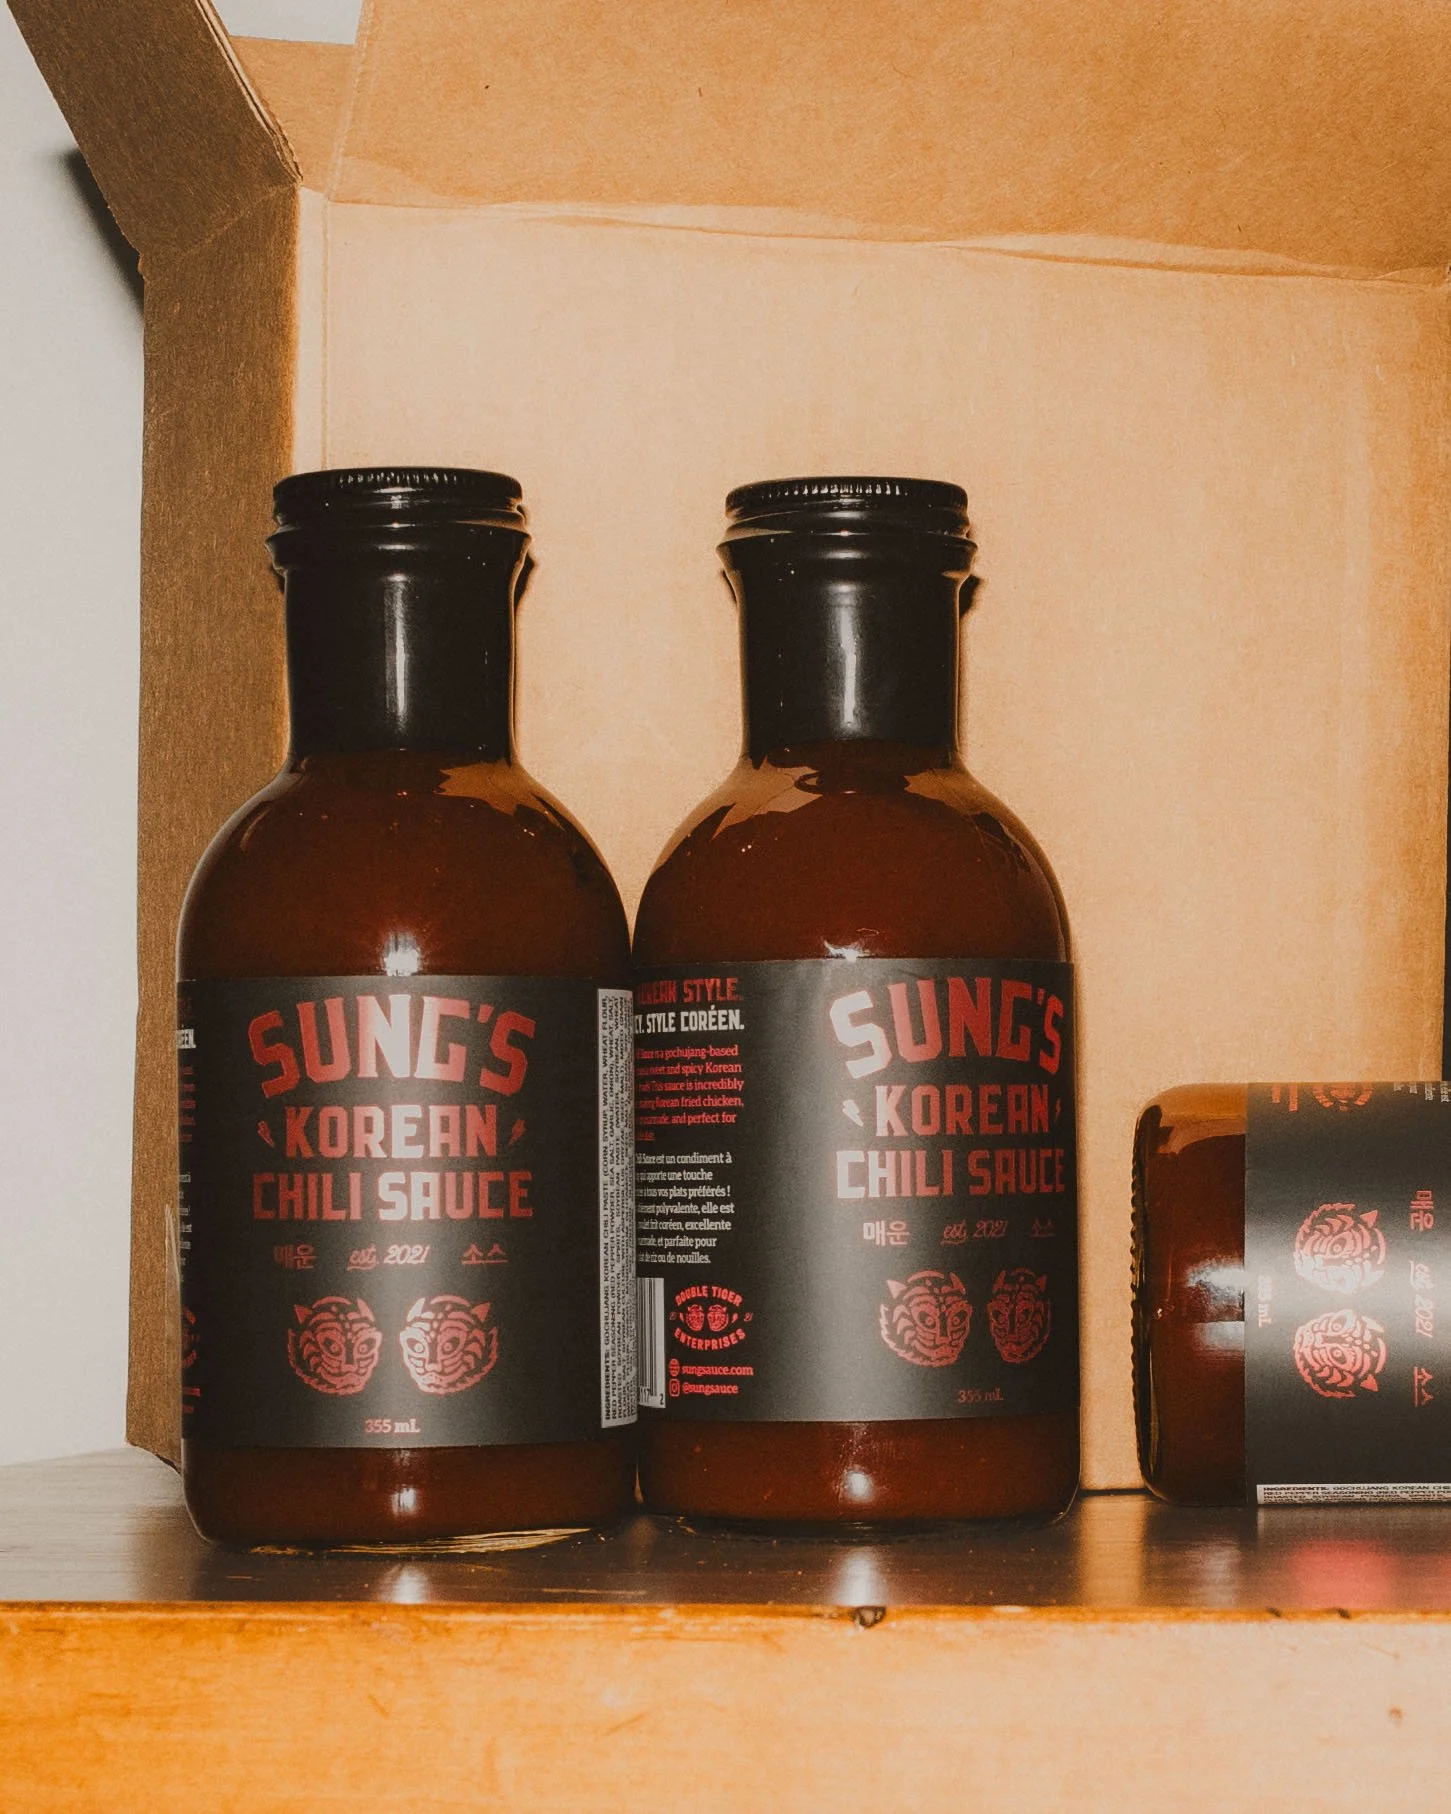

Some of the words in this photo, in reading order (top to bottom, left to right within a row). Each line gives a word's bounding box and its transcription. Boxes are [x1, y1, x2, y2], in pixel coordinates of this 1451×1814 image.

[683, 976, 744, 1003] STYLE.
[646, 1011, 677, 1034] STYLE
[680, 1005, 745, 1032] CORÉEN.
[829, 976, 1064, 1080] SUNG'S
[248, 994, 536, 1099] SUNG'S
[665, 1045, 739, 1060] gochujang-based
[681, 1064, 704, 1077] spicy
[705, 1062, 743, 1074] Korean
[686, 1080, 693, 1090] is
[694, 1078, 744, 1091] incredibly
[681, 1097, 702, 1107] fried
[702, 1095, 745, 1107] chicken,
[875, 1084, 1049, 1137] KOREAN
[671, 1112, 686, 1124] and
[687, 1112, 720, 1126] perfect
[721, 1111, 737, 1123] for
[285, 1104, 497, 1158] KOREAN
[666, 1156, 676, 1164] un
[677, 1152, 725, 1164] condiment
[725, 1152, 733, 1164] à
[667, 1172, 683, 1181] une
[683, 1169, 714, 1181] touche
[836, 1149, 954, 1199] CHILI
[967, 1148, 1064, 1195] SAUCE
[253, 1171, 363, 1221] CHILI
[377, 1170, 534, 1221] SAUCE
[669, 1186, 688, 1199] plats
[688, 1185, 726, 1199] préférés
[701, 1202, 719, 1213] elle
[719, 1203, 735, 1214] est
[1410, 1190, 1434, 1231] 매운
[685, 1219, 732, 1230] excellente
[862, 1220, 910, 1246] 매운
[973, 1219, 1008, 1239] 2021
[664, 1236, 695, 1249] parfaite
[695, 1238, 718, 1249] pour
[274, 1243, 317, 1270] 매운
[384, 1243, 431, 1265] 2021
[461, 1242, 509, 1266] 소스
[667, 1251, 676, 1263] de
[676, 1251, 712, 1264] nouilles.
[675, 1285, 708, 1306] DOUBLE
[711, 1285, 743, 1307] TIGER
[1414, 1294, 1434, 1338] 2021
[674, 1327, 746, 1351] ENTERPRISES
[682, 1365, 754, 1377] sungsauce.com
[682, 1382, 739, 1395] @sungsauce
[1413, 1366, 1434, 1407] 소스
[365, 1418, 392, 1433] 355
[394, 1417, 421, 1433] mL
